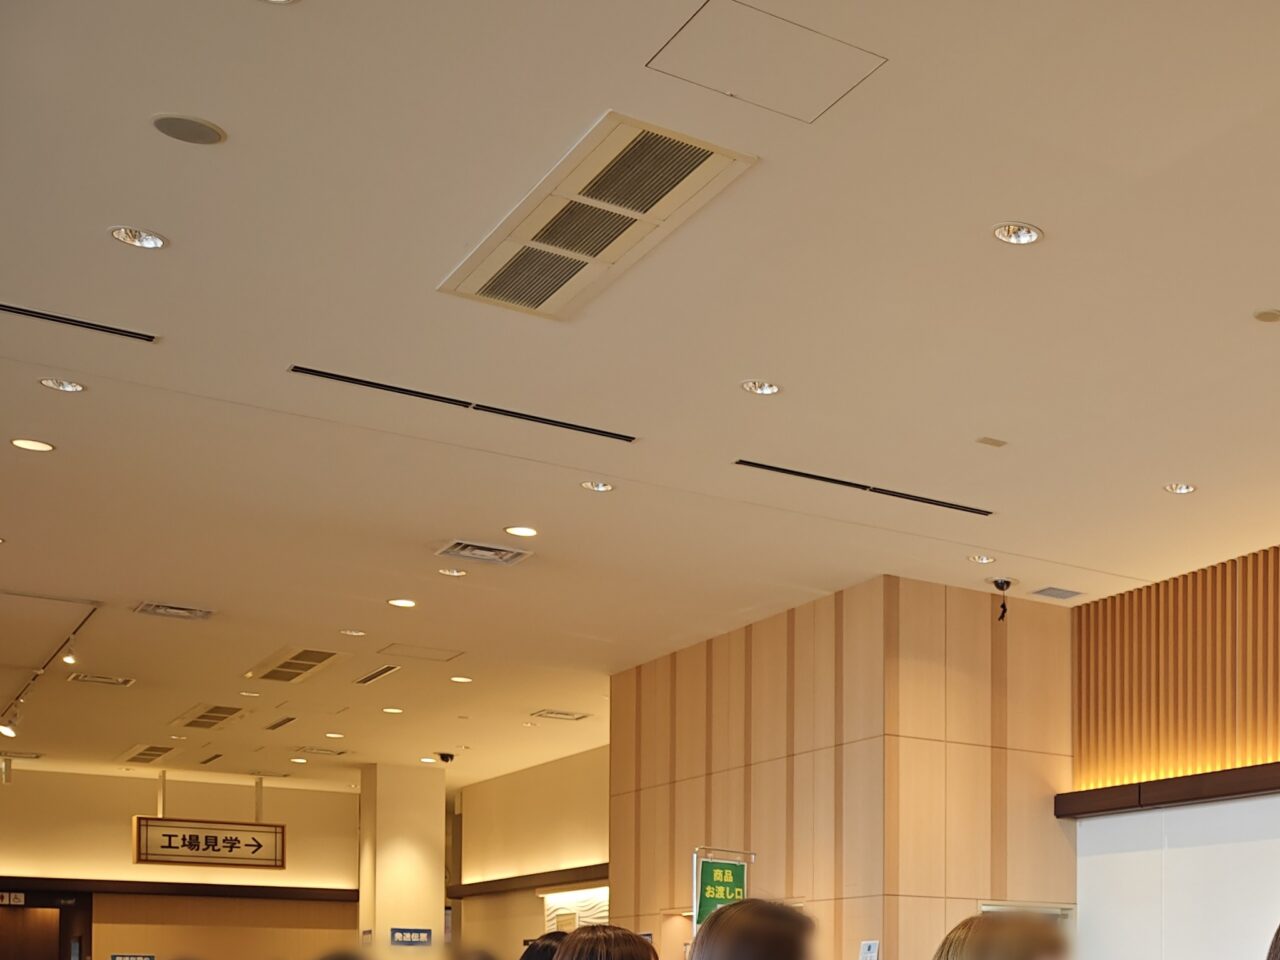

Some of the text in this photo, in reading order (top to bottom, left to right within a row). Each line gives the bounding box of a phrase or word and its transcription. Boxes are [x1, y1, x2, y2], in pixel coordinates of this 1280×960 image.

[160, 833, 241, 853] 工場見学
[713, 868, 734, 883] 商品
[705, 885, 743, 900] お渡し口
